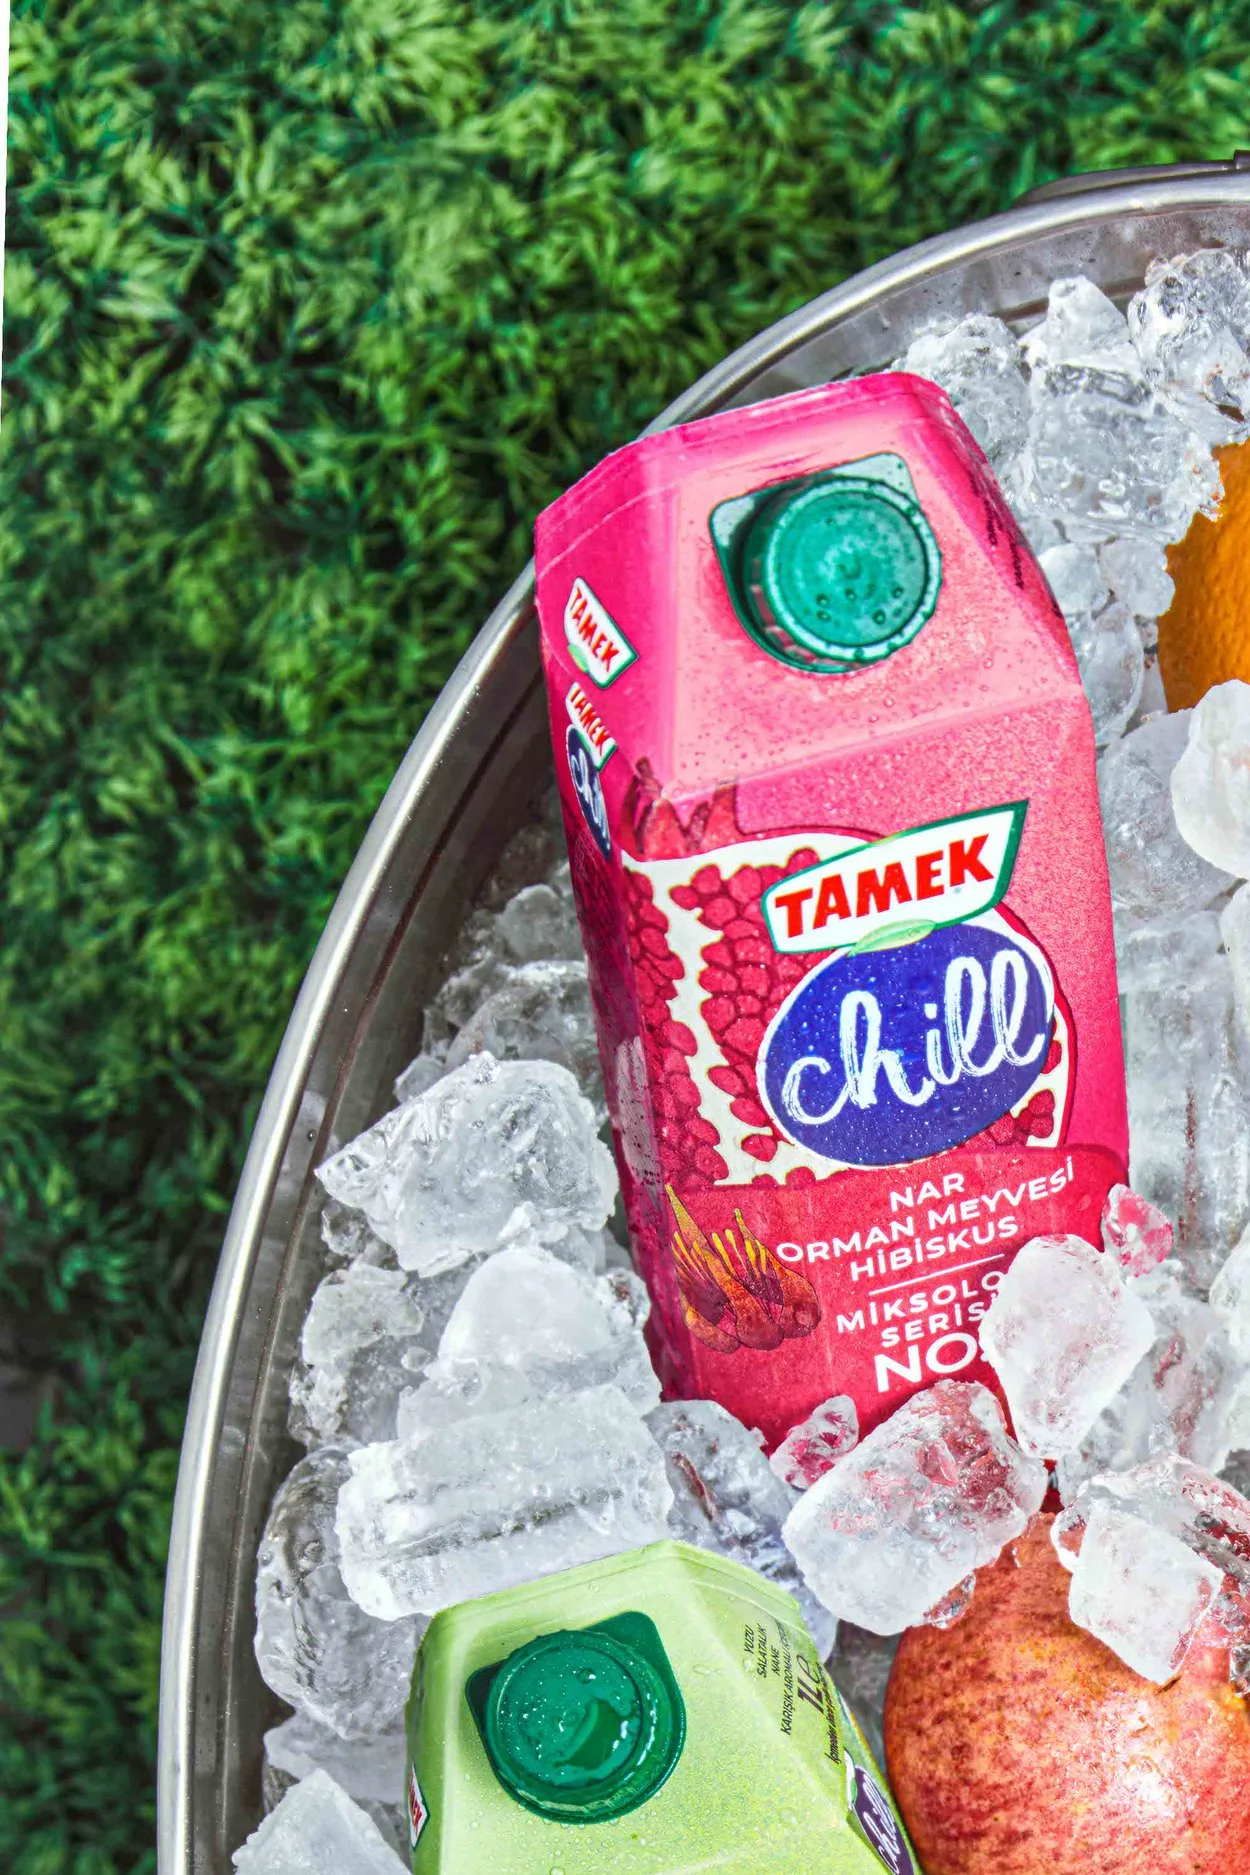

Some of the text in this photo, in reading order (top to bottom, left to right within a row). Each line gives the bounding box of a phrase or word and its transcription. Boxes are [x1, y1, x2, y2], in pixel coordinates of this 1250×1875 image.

[570, 586, 620, 673] TAMEK
[570, 687, 610, 755] TAMEK
[774, 834, 994, 939] TAMEK
[782, 950, 1045, 1125] chill
[776, 1156, 1075, 1264] ORMAN MEYVESİ
[889, 1173, 966, 1212] NAR
[851, 1216, 1020, 1282] HİBİSKUS
[837, 1270, 1003, 1334] MİKSOLO
[881, 1302, 985, 1348] SERİS
[744, 1624, 756, 1654] YUZU
